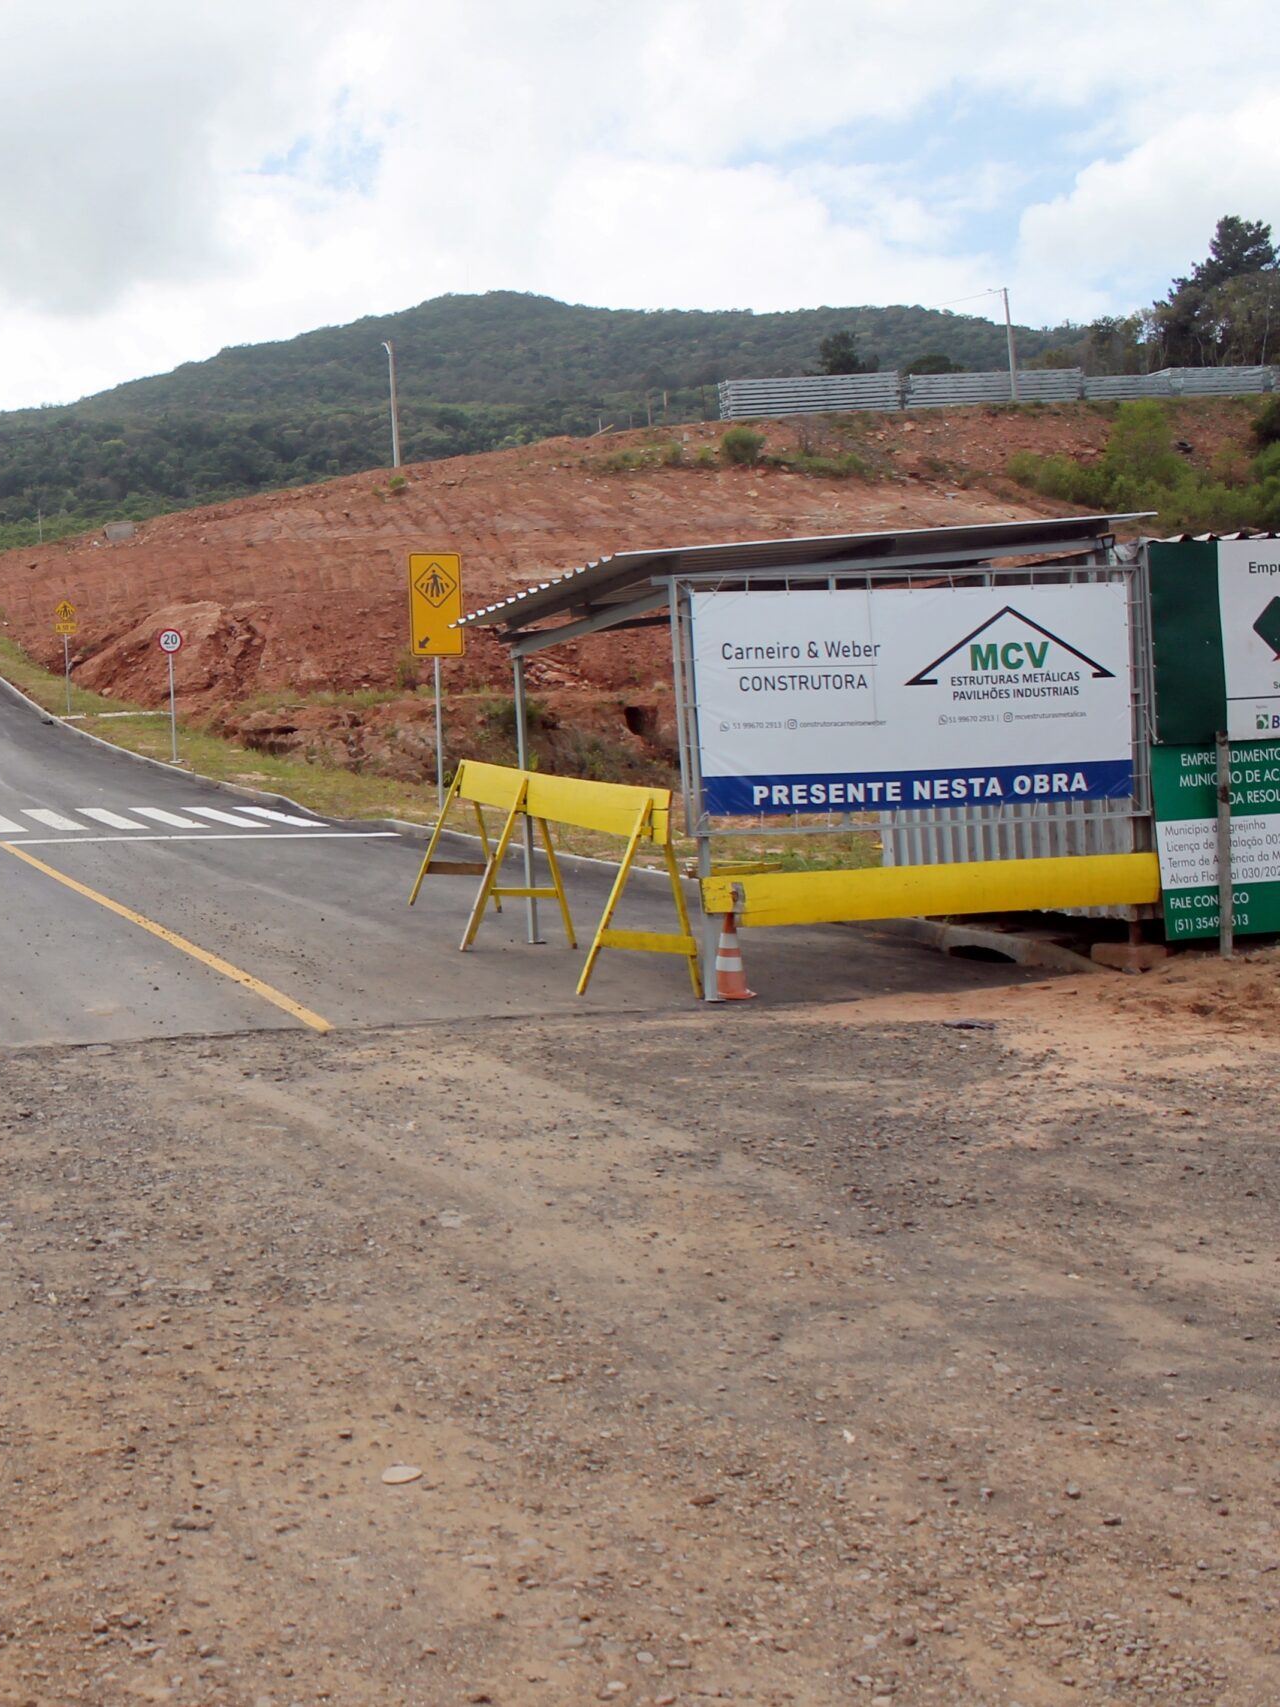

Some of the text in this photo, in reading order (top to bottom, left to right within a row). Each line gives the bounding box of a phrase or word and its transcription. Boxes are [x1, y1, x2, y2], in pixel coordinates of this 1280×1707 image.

[163, 634, 178, 645] 20
[721, 640, 881, 661] Carneiro & Weber
[969, 640, 1049, 671] MCV
[739, 674, 868, 692] CONSTRUTORA
[951, 670, 1080, 687] ESTRUTURAS METÁLICAS
[1273, 681, 1280, 689] S
[952, 685, 1080, 701] PAVILHÕES INDUSTRIAIS
[1181, 748, 1280, 767] EMPREDIMENTO
[1179, 770, 1242, 788] MUNICIO
[1245, 769, 1261, 783] DE
[753, 771, 1089, 805] PRESENTE NESTA OBRA
[1229, 819, 1266, 833] grejinha
[1166, 842, 1200, 853] Licença
[1203, 839, 1215, 850] de
[1168, 857, 1196, 868] Termo
[1198, 856, 1211, 866] de
[1257, 851, 1269, 861] da
[1169, 873, 1199, 885] Alvará
[1170, 892, 1249, 909] FALE CONCO
[1174, 918, 1193, 933] (51)
